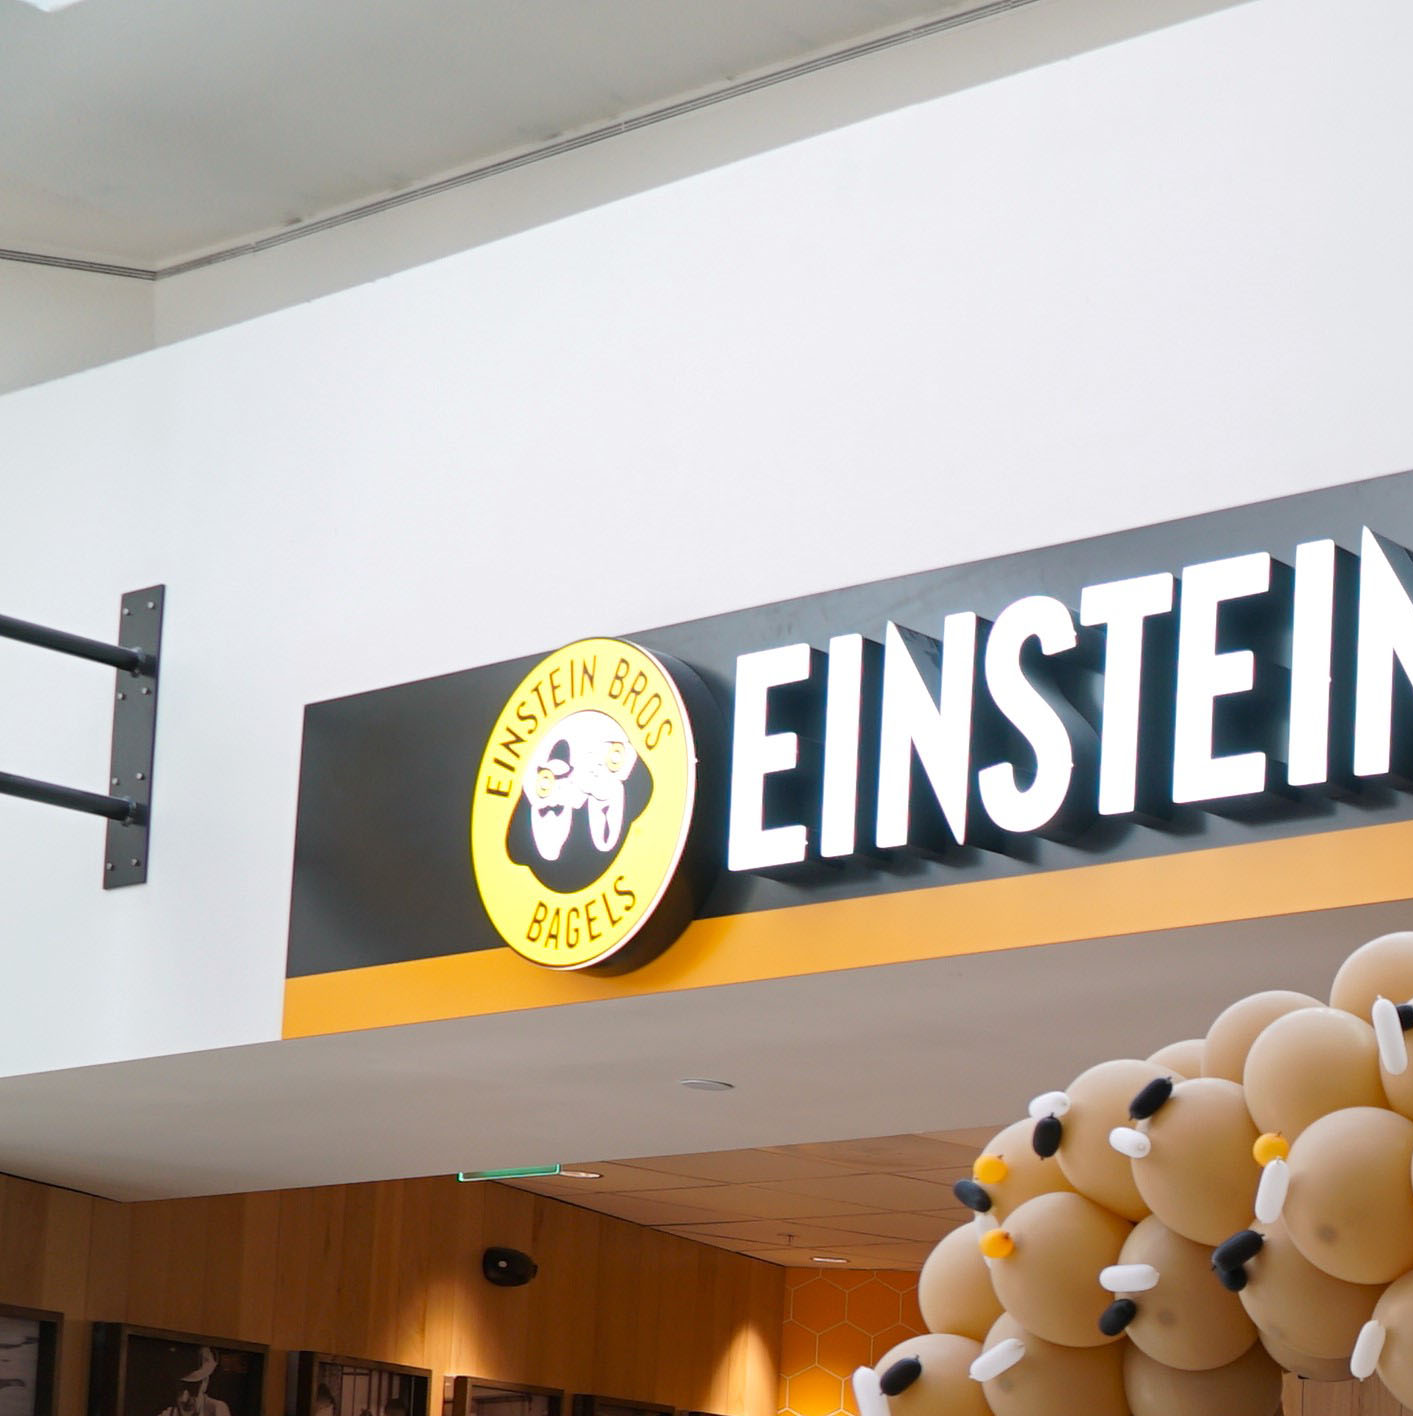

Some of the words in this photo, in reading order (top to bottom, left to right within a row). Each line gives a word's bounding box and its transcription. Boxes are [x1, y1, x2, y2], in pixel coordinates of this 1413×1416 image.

[486, 655, 597, 799] EINSTEIN
[608, 658, 673, 751] BROS
[526, 875, 636, 950] BAGELS
